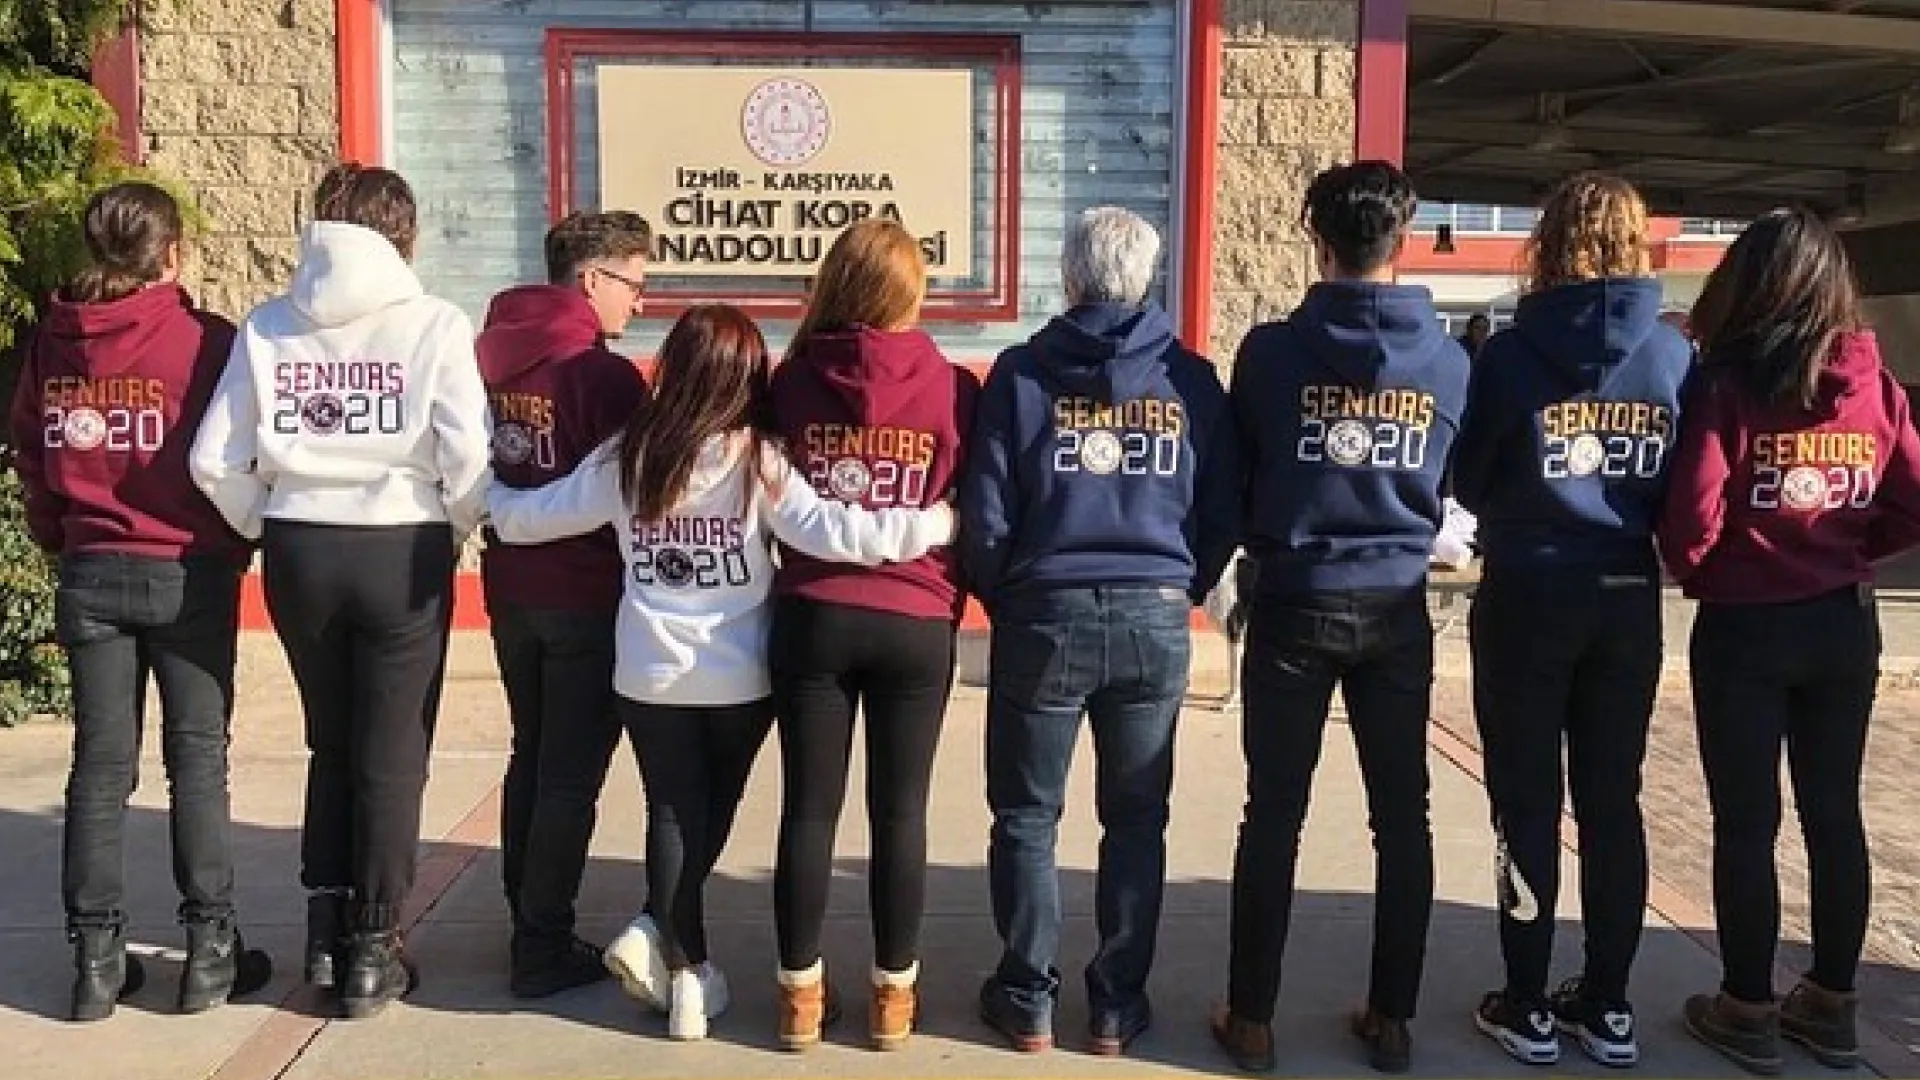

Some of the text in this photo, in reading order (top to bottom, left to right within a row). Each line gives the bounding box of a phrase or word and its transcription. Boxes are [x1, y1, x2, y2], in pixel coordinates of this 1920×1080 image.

[676, 166, 740, 188] İZMİR
[763, 171, 894, 194] KARŞIYAKA
[665, 191, 782, 230] CİHAT
[647, 233, 823, 265] NADOLU
[44, 378, 164, 411] SENIORS
[274, 362, 404, 394] SENIORS
[44, 405, 164, 451] 2020
[273, 393, 404, 436] 2020
[1055, 396, 1184, 436] SENIORS
[1302, 385, 1434, 430] SENIORS
[1543, 401, 1670, 440] SENIORS
[805, 423, 936, 466] SENIORS
[1054, 427, 1177, 475] 2020
[1297, 419, 1427, 468] 2020
[1542, 433, 1666, 478] 2020
[1753, 433, 1876, 466] SENIORS
[1750, 464, 1877, 510] 2020
[631, 515, 744, 552] SENIORS
[632, 547, 751, 589] 2020
